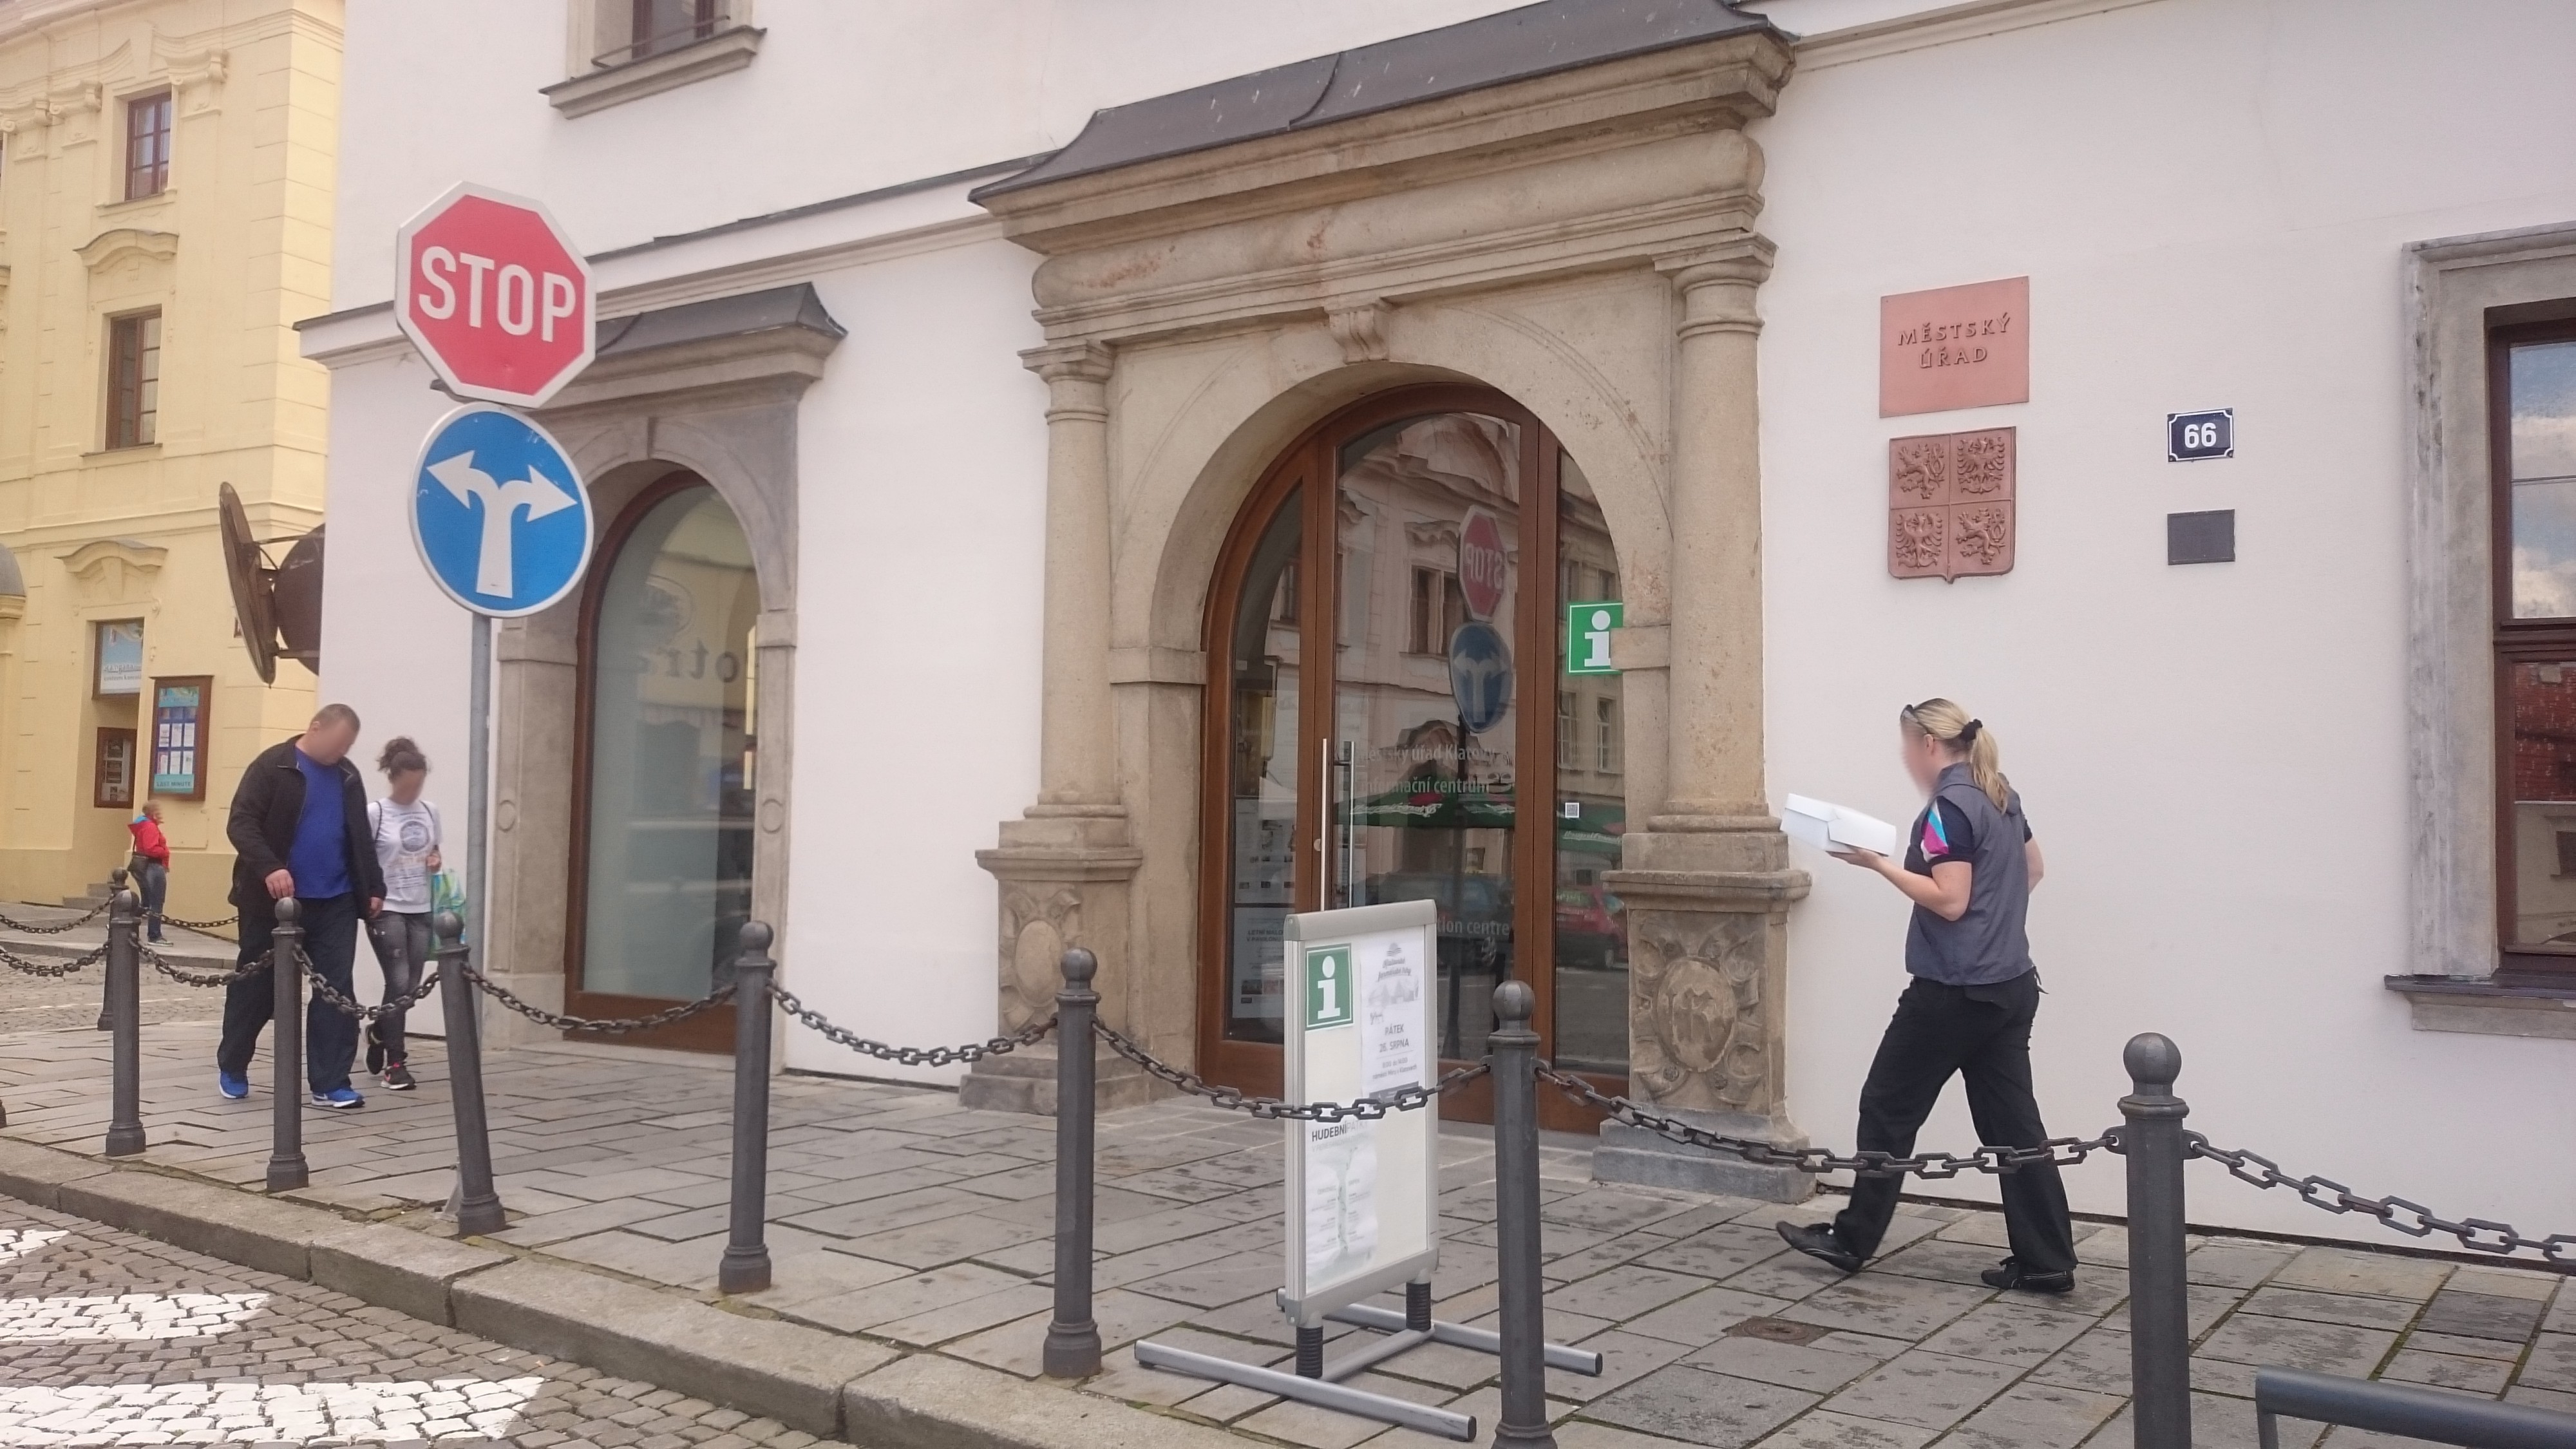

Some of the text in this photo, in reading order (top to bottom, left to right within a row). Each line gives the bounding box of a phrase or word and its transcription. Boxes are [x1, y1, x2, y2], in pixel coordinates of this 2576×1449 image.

[418, 245, 576, 343] STOP
[1898, 312, 2011, 346] MĚSTSKÝ
[1920, 346, 1987, 368] ÚŘAD
[2184, 422, 2217, 448] 66
[1434, 779, 1490, 794] centrum
[1466, 919, 1510, 936] centre
[1385, 1023, 1405, 1036] PÁTEK
[1390, 1038, 1409, 1050] SRPNA
